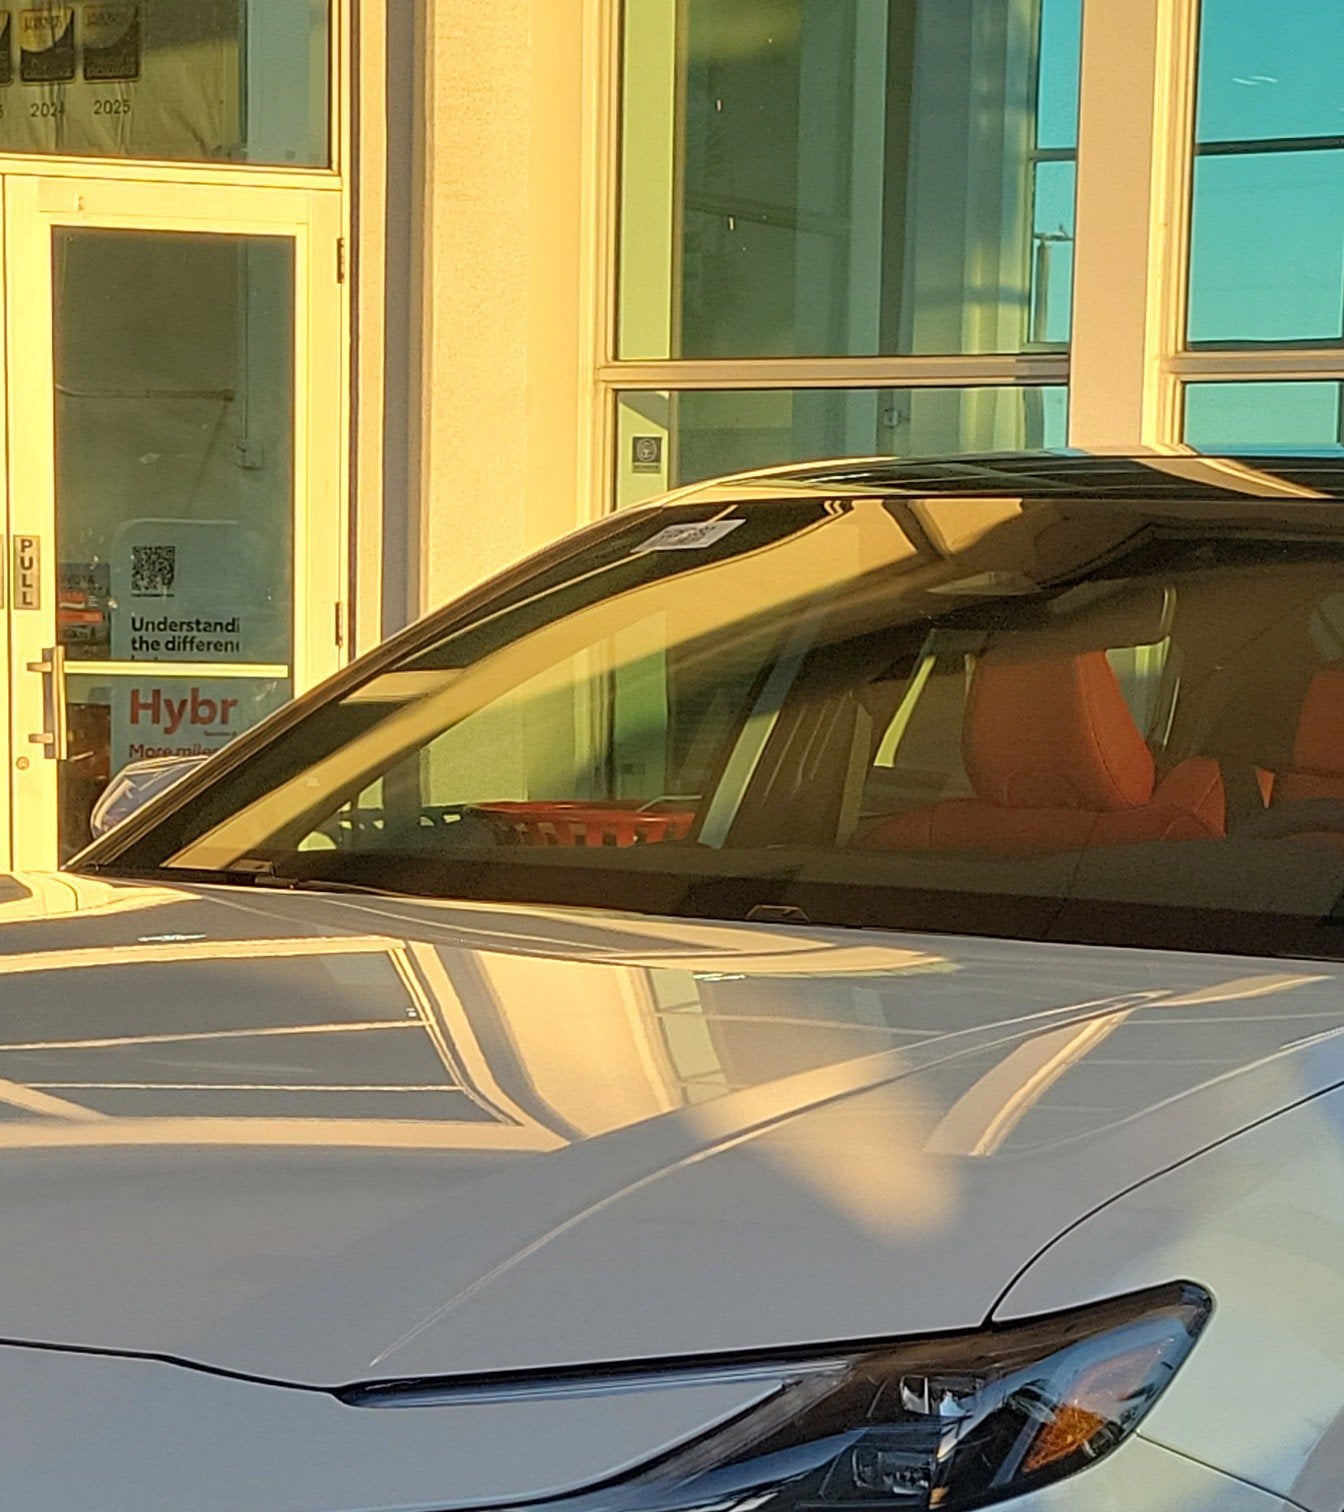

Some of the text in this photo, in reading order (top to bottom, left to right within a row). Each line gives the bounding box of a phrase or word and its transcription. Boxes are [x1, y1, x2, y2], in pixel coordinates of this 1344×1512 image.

[30, 102, 65, 118] 2024
[93, 99, 131, 115] 2025
[20, 538, 34, 606] PULL
[131, 635, 161, 652] the
[130, 687, 238, 735] Hybr
[129, 743, 171, 758] More
